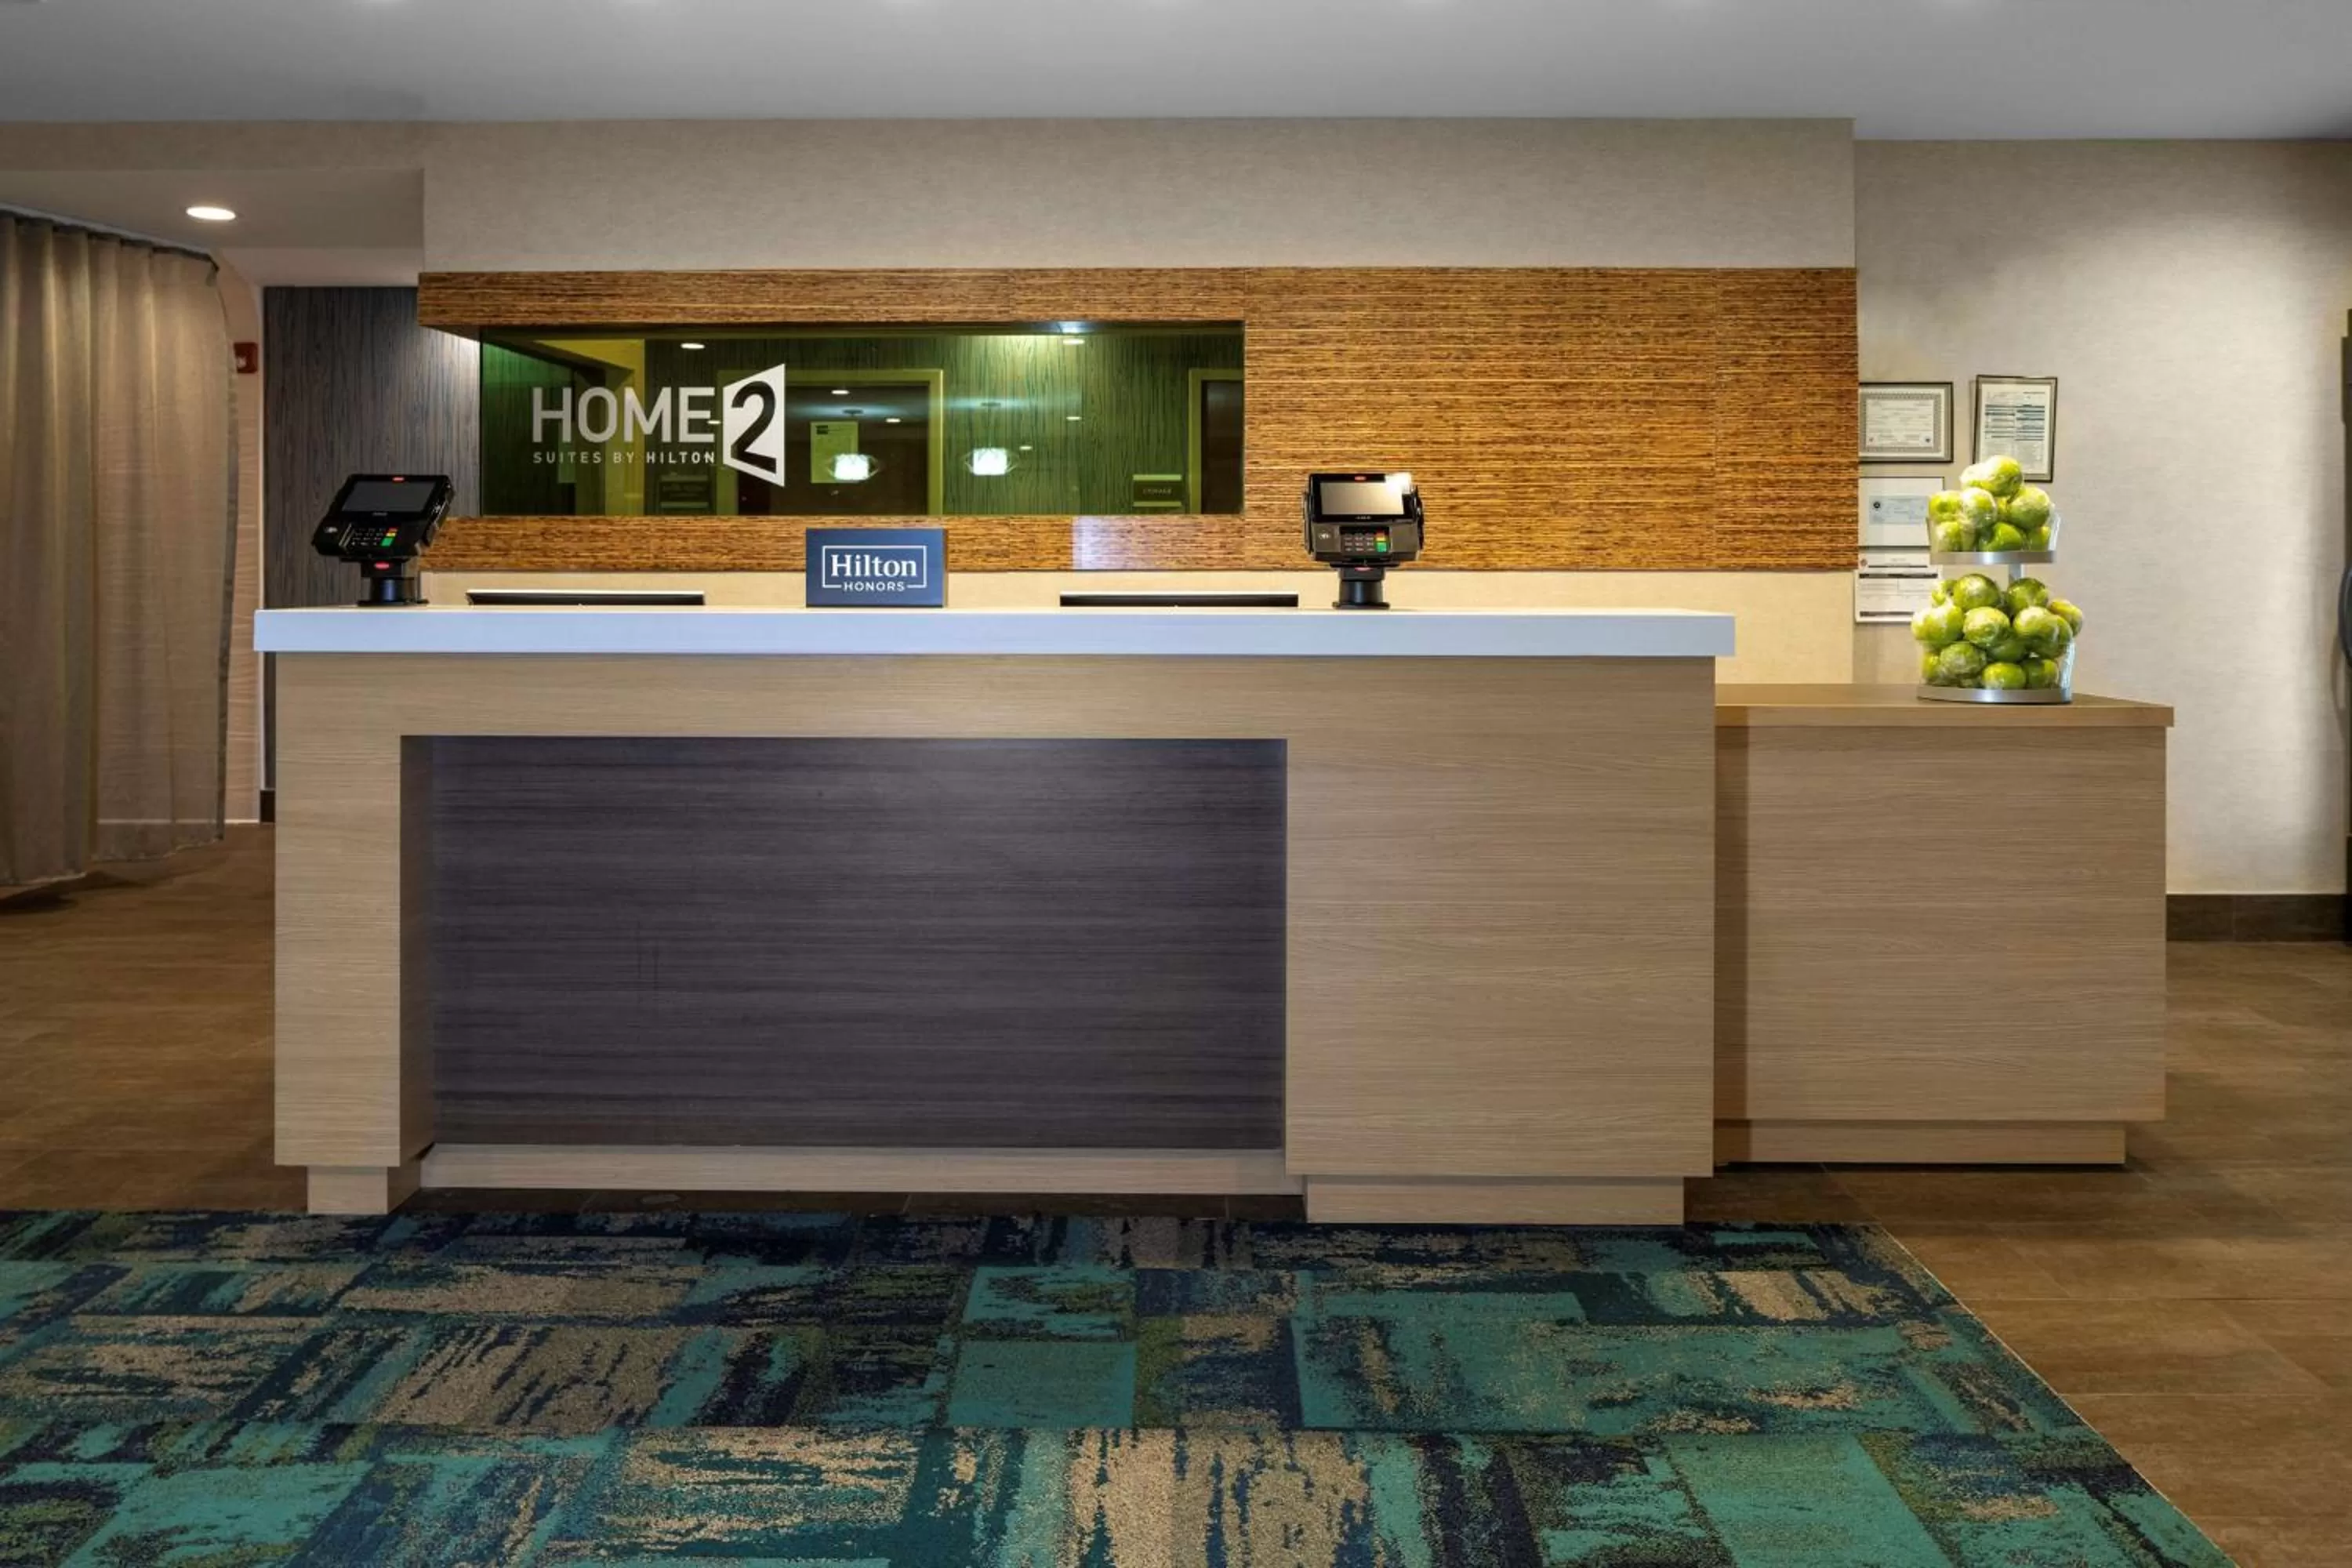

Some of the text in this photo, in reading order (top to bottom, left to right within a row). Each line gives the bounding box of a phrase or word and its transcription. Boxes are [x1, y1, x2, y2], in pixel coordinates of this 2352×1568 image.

[532, 381, 777, 474] HOME 2
[533, 452, 714, 463] SUITES BY HILTON
[830, 554, 917, 577] Hilton
[844, 581, 905, 592] HONORS
